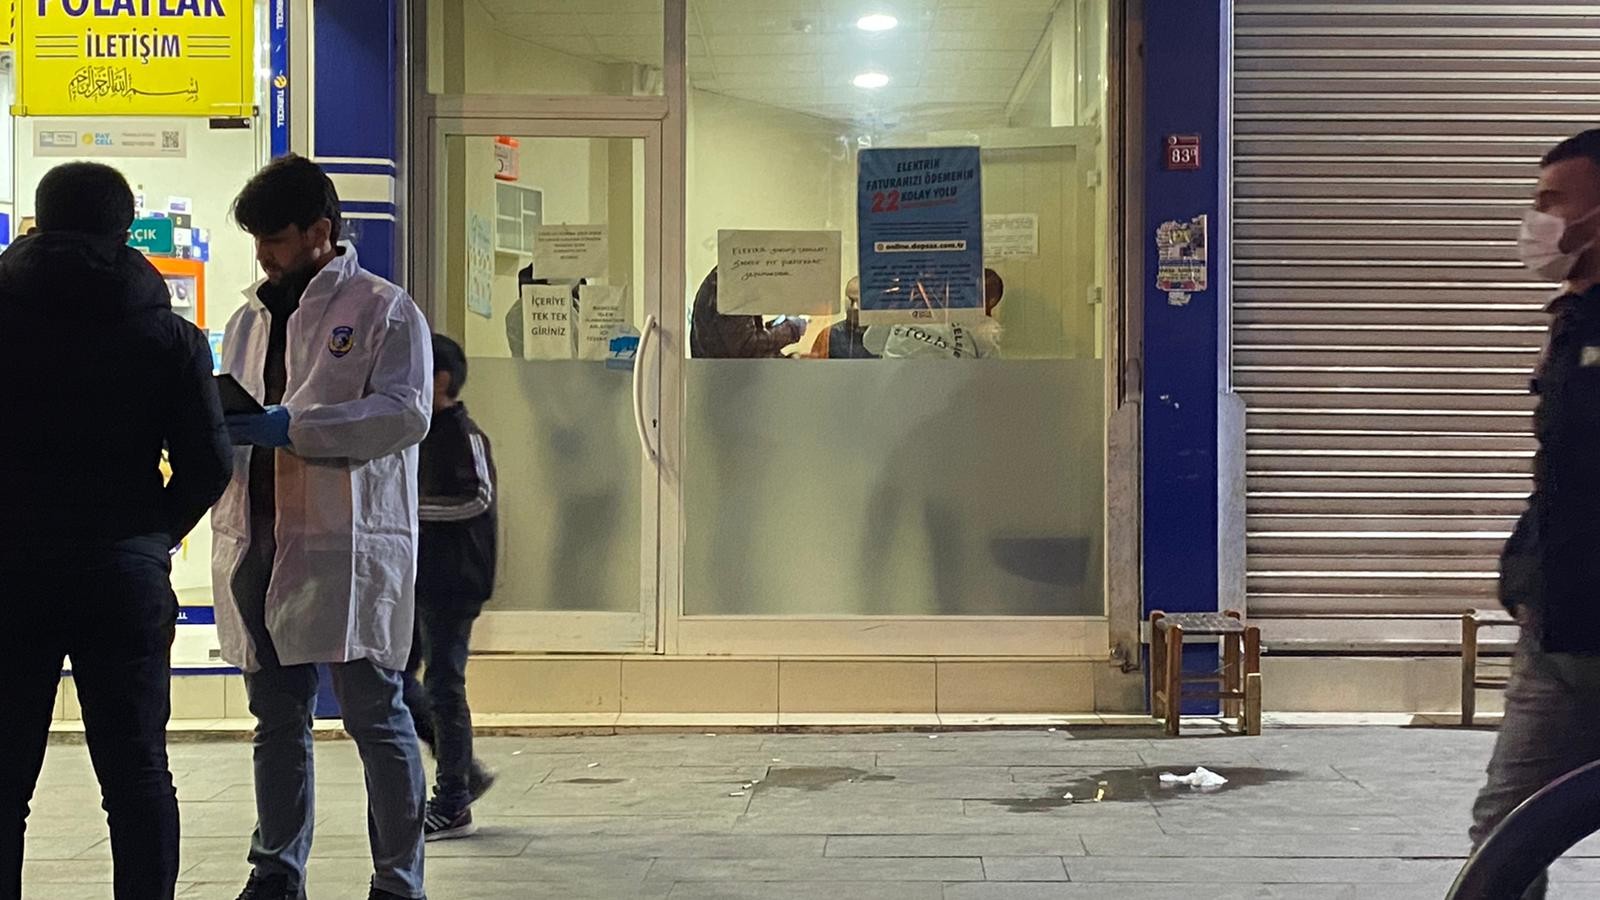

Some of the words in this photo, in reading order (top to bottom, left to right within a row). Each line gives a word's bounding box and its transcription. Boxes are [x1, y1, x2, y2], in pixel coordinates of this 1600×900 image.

[86, 27, 181, 64] İLETİŞİM
[276, 89, 285, 129] TURKCELL
[94, 138, 113, 146] CELL
[866, 177, 922, 191] FATURANIZI
[924, 168, 975, 185] ÖDEMENİN
[871, 189, 900, 214] 22
[900, 189, 931, 202] KOLAY
[933, 186, 958, 198] YOLU
[531, 295, 566, 308] İÇERİYE
[532, 312, 549, 321] TEK
[551, 312, 568, 321] TEK
[531, 325, 566, 336] GİRİNİZ
